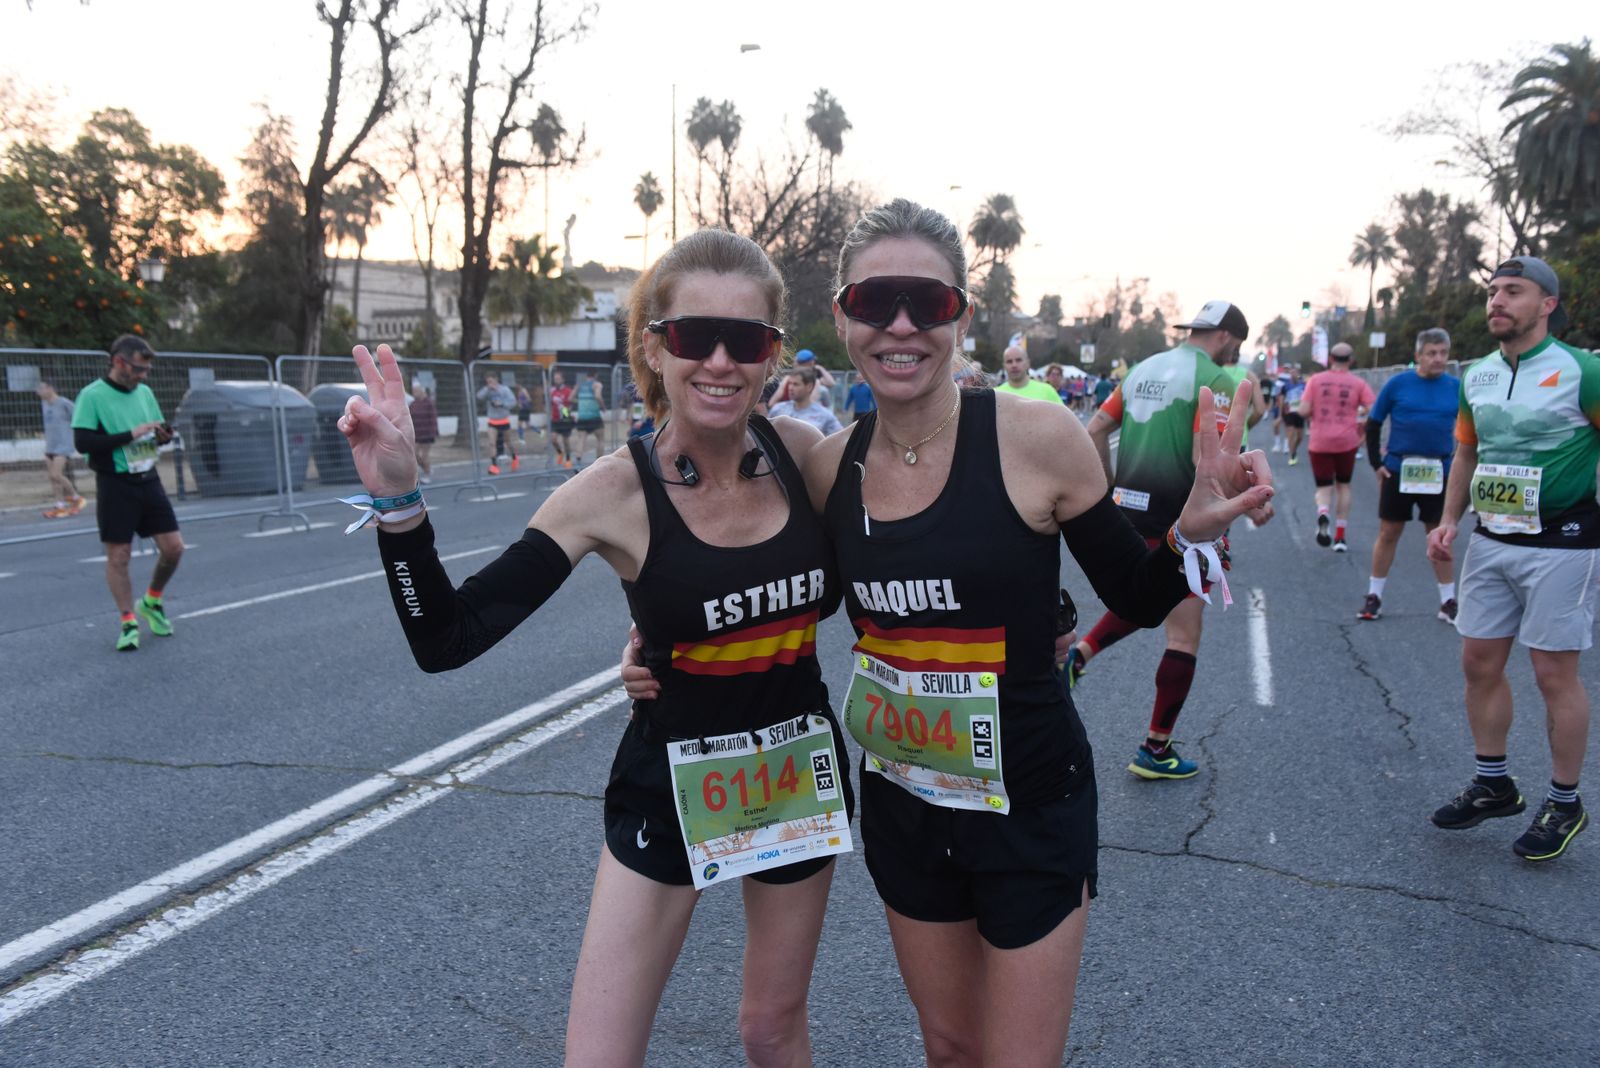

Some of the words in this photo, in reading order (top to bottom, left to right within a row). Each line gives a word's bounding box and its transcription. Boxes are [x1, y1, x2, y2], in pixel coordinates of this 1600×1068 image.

[1136, 380, 1166, 394] alcor
[1477, 481, 1517, 504] 6422
[393, 561, 424, 617] KIPRUN
[703, 568, 825, 632] ESTHER
[853, 578, 962, 617] RAQUEL
[875, 663, 899, 686] MARATÓN
[922, 673, 972, 694] SEVILLA
[864, 692, 957, 752] 7904
[679, 741, 706, 757] MEDI
[709, 735, 748, 752] MARATÓN
[702, 754, 800, 812] 6114
[913, 786, 935, 797] HOKA
[744, 806, 768, 816] Esther
[757, 849, 781, 861] HOKA
